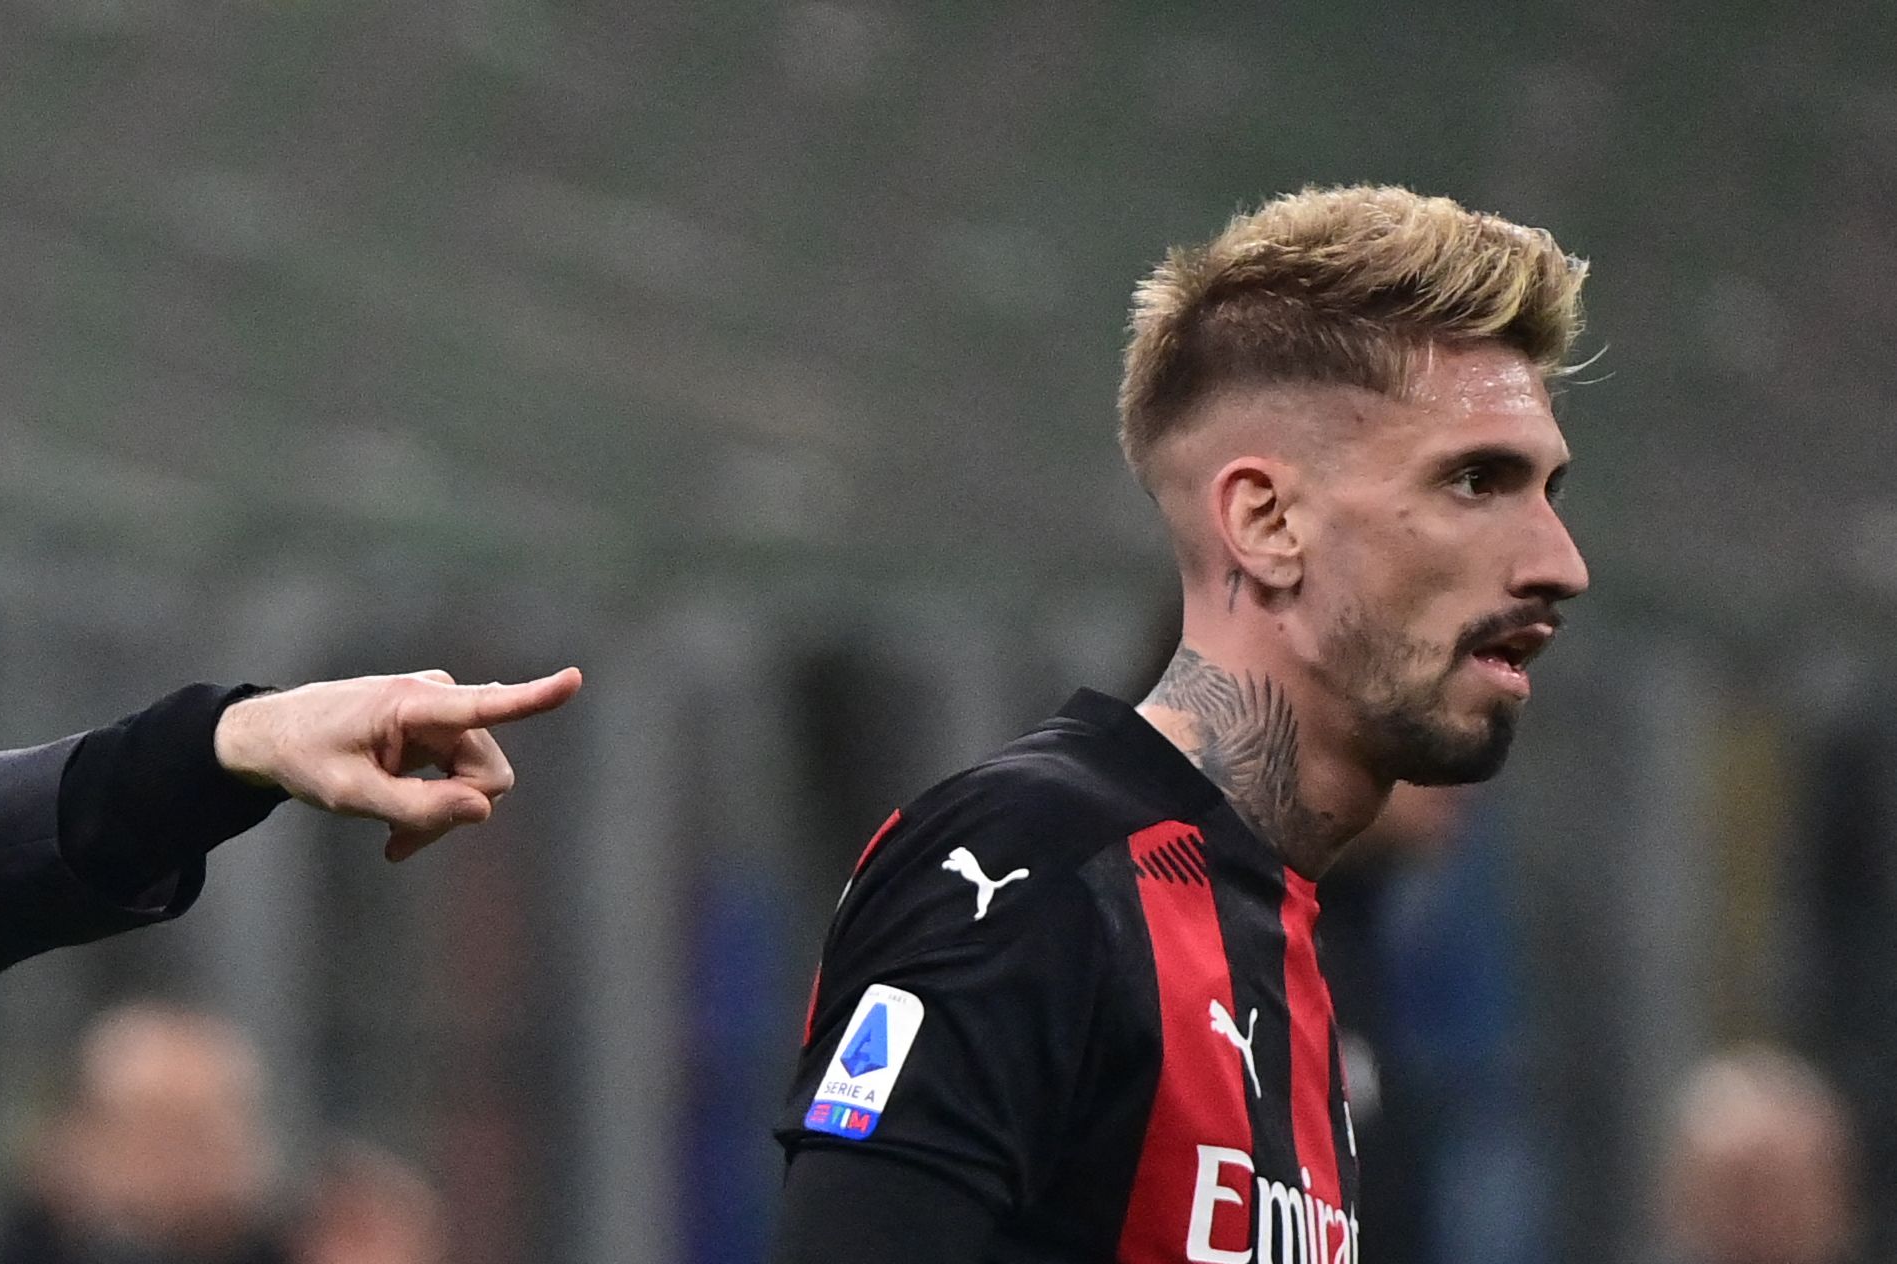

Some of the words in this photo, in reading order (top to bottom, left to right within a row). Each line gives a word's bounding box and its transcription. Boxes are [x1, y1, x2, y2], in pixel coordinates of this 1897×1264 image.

[824, 1082, 863, 1099] SERIE
[864, 1089, 876, 1103] A
[831, 1103, 871, 1133] TIM
